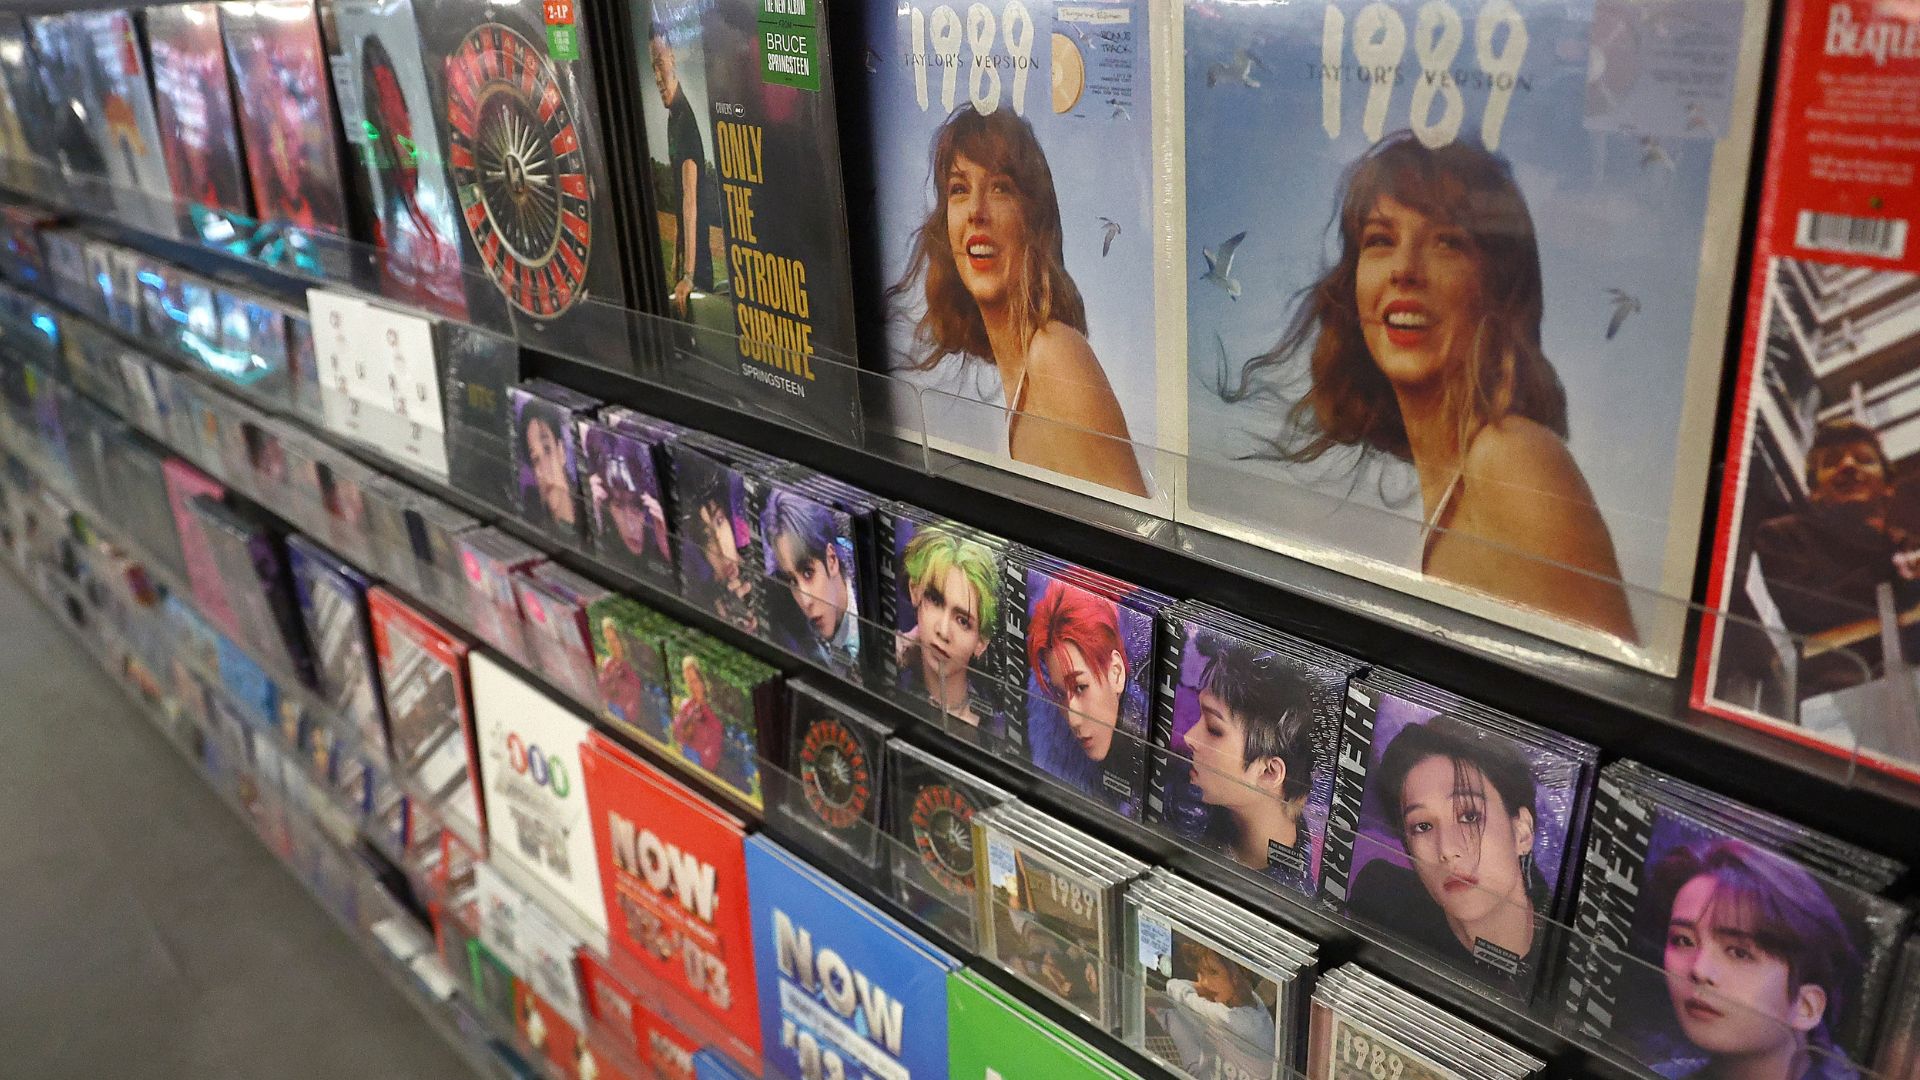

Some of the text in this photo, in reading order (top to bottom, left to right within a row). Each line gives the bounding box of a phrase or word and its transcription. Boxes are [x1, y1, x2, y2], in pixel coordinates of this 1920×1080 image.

[766, 32, 808, 54] BRUCE
[767, 53, 810, 76] SPRINGSTEEN
[904, 53, 1040, 70] TAYLOR'S VERSION
[911, 1, 1034, 117] 1989
[1322, 0, 1528, 152] 1989
[1424, 68, 1533, 93] VERSION
[717, 120, 763, 184] ONLY
[723, 183, 757, 245] THE
[731, 243, 810, 319] STRONG
[737, 303, 816, 382] SURVIVE
[741, 362, 806, 398] SPRINGSTEEN
[608, 810, 718, 925] NOW
[1049, 871, 1095, 921] 1989
[772, 907, 904, 1057] NOW
[1343, 1028, 1404, 1080] 1989
